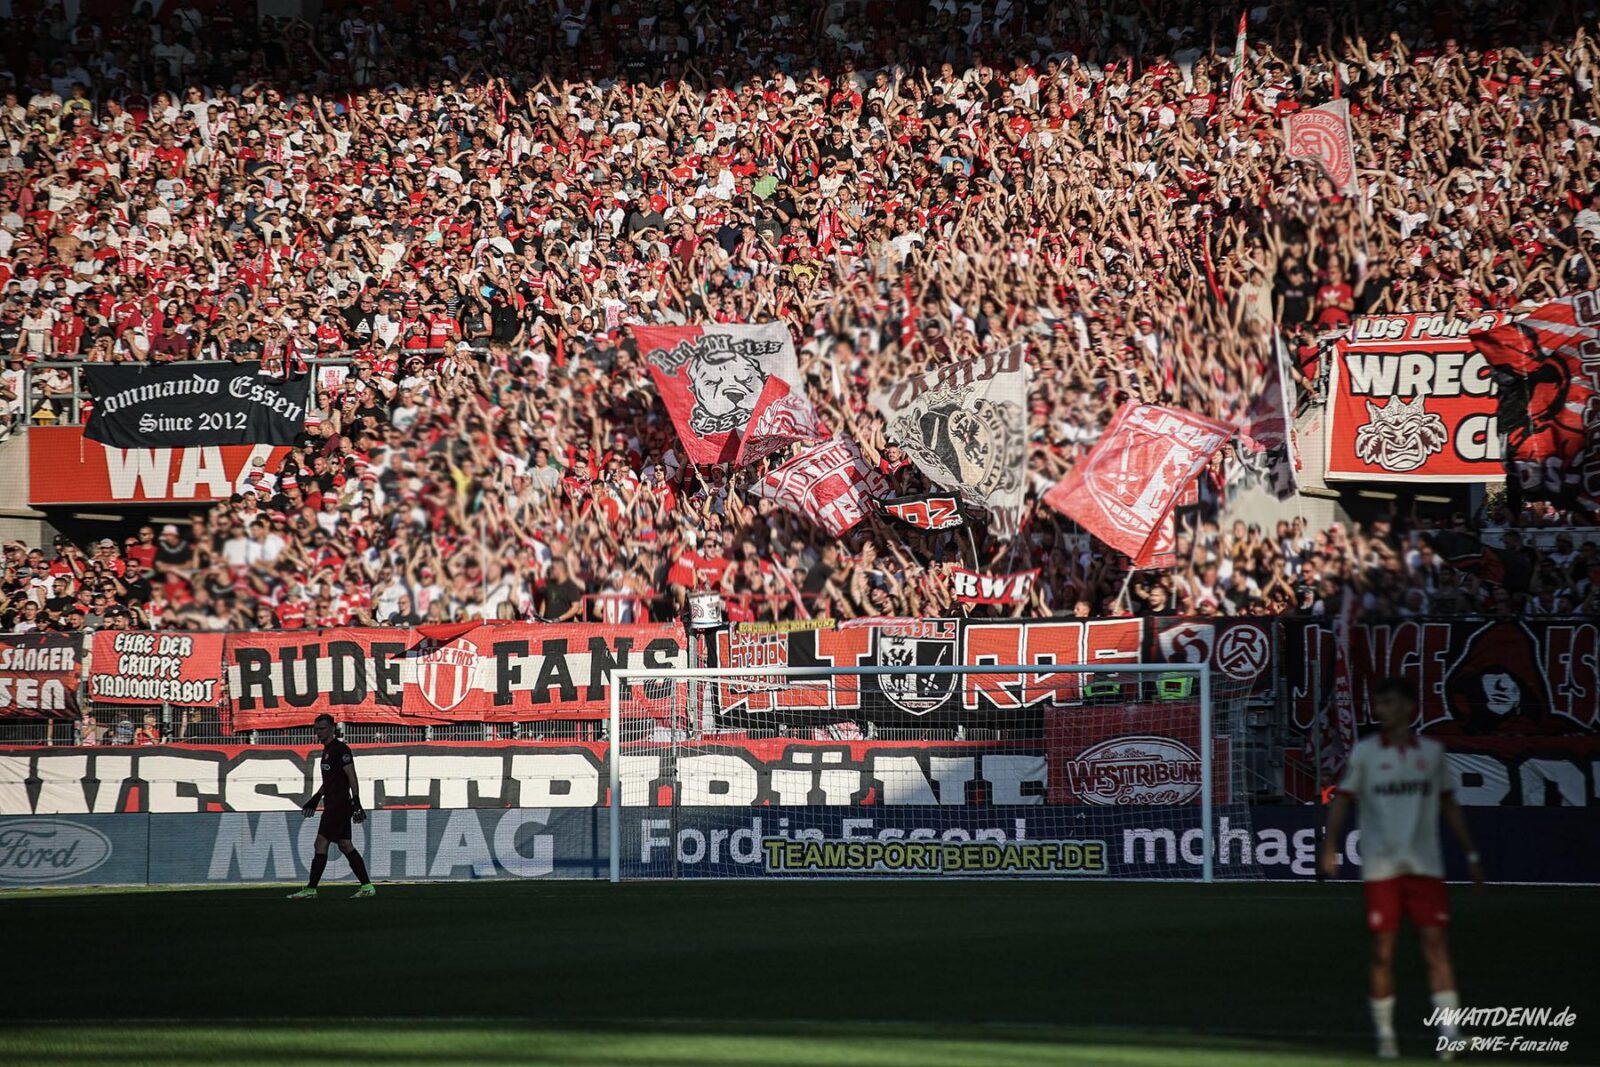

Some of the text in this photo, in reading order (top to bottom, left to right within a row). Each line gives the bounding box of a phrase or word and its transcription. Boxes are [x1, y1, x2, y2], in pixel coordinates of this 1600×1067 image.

[1356, 317, 1407, 339] LOS
[1345, 351, 1498, 396] WREC
[95, 373, 219, 417] ommando
[228, 375, 302, 423] Essen
[138, 411, 248, 433] Since 2012
[114, 633, 193, 657] EHRE DER
[118, 654, 182, 678] GRUPPE
[235, 636, 680, 711] RUDE FANS
[1293, 621, 1452, 729] JNGE
[91, 673, 218, 702] STADIONVERBOT
[1066, 759, 1203, 797] WESTTRIBÜN
[0, 828, 79, 871] Ford
[641, 817, 763, 865] Ford
[765, 841, 1104, 870] TEAMSPORTBEDARF.DE
